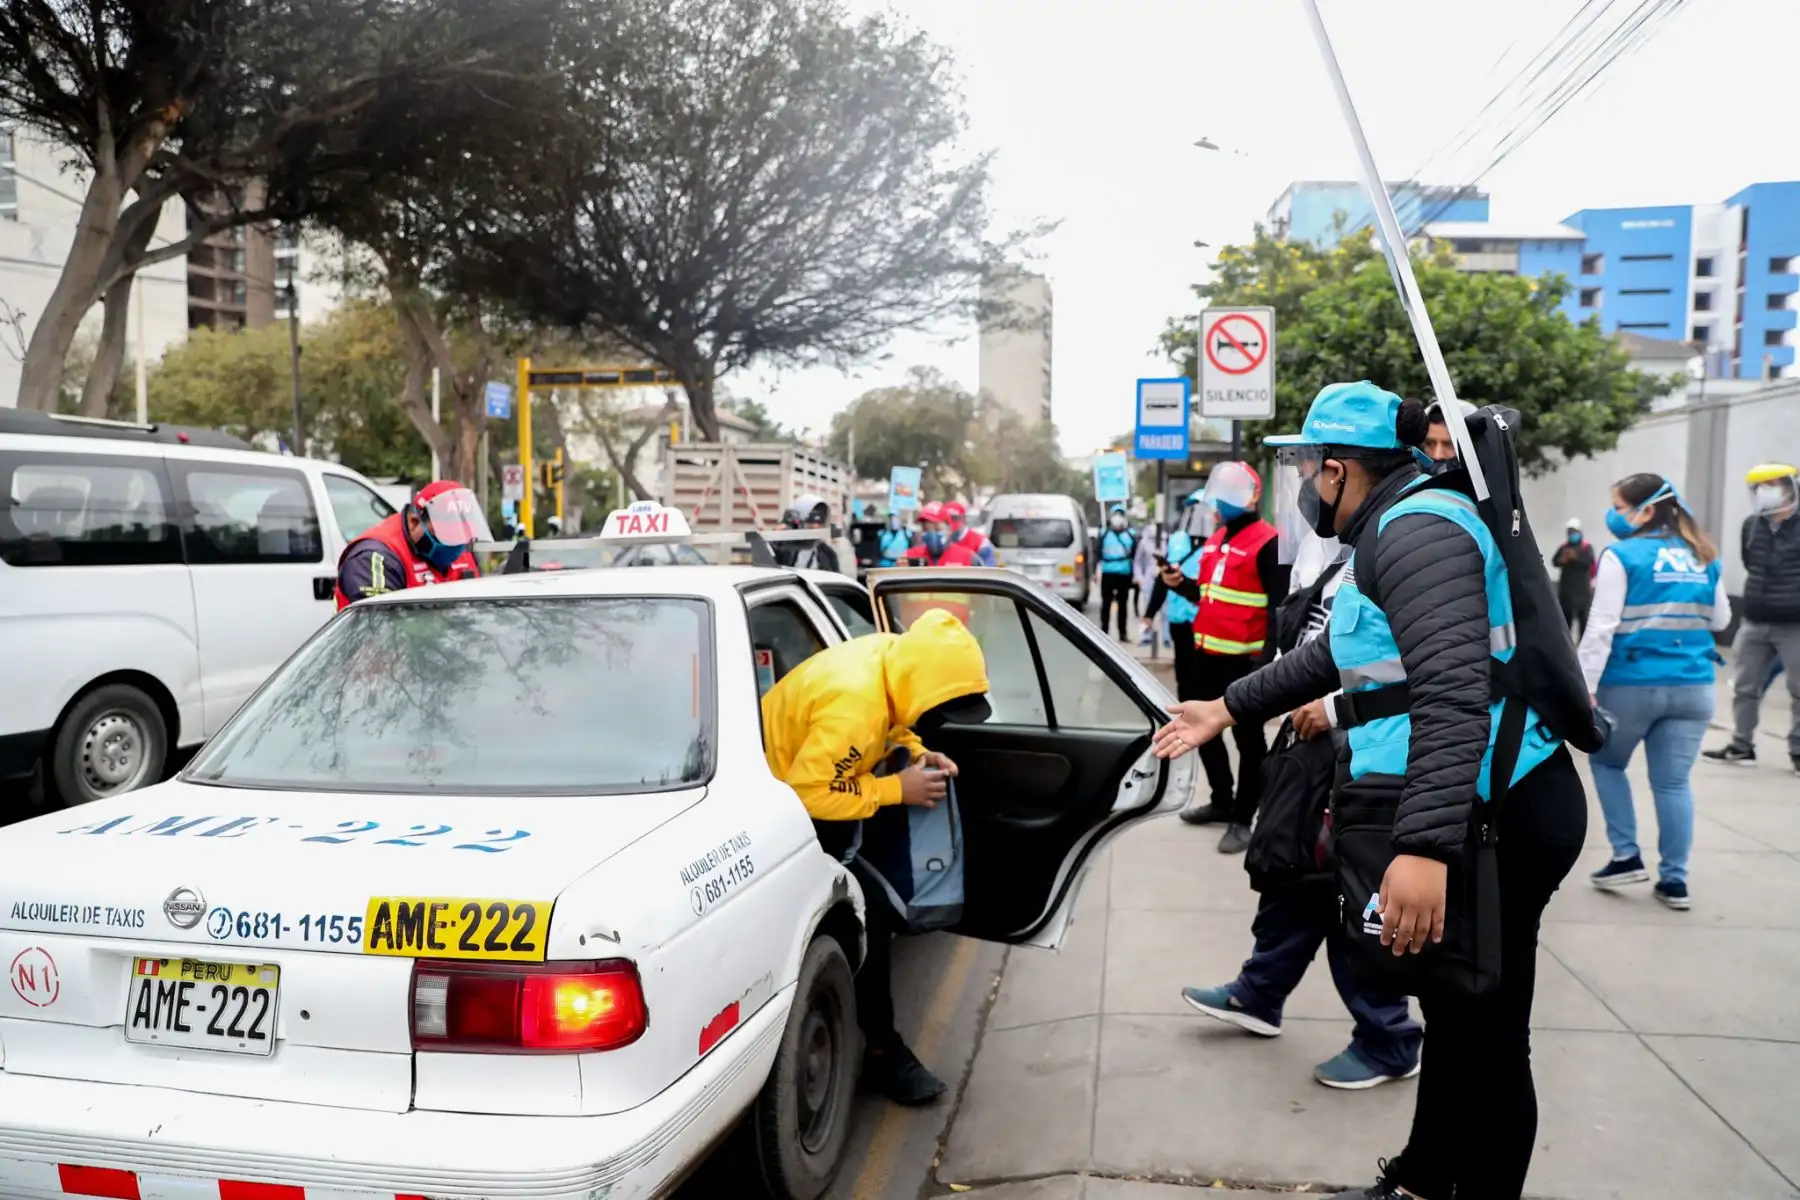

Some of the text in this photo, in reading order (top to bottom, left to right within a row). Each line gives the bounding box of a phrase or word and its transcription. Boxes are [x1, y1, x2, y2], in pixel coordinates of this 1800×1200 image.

[1206, 389, 1269, 401] SILENCIO
[616, 513, 669, 534] TAXI
[680, 830, 752, 886] ALQUILER DE TAXIS
[705, 854, 755, 904] 681-1155
[11, 900, 145, 928] ALQUILER DE TAXIS
[166, 902, 200, 912] NISSAN
[181, 961, 234, 981] PERU
[132, 978, 271, 1040] AME-222
